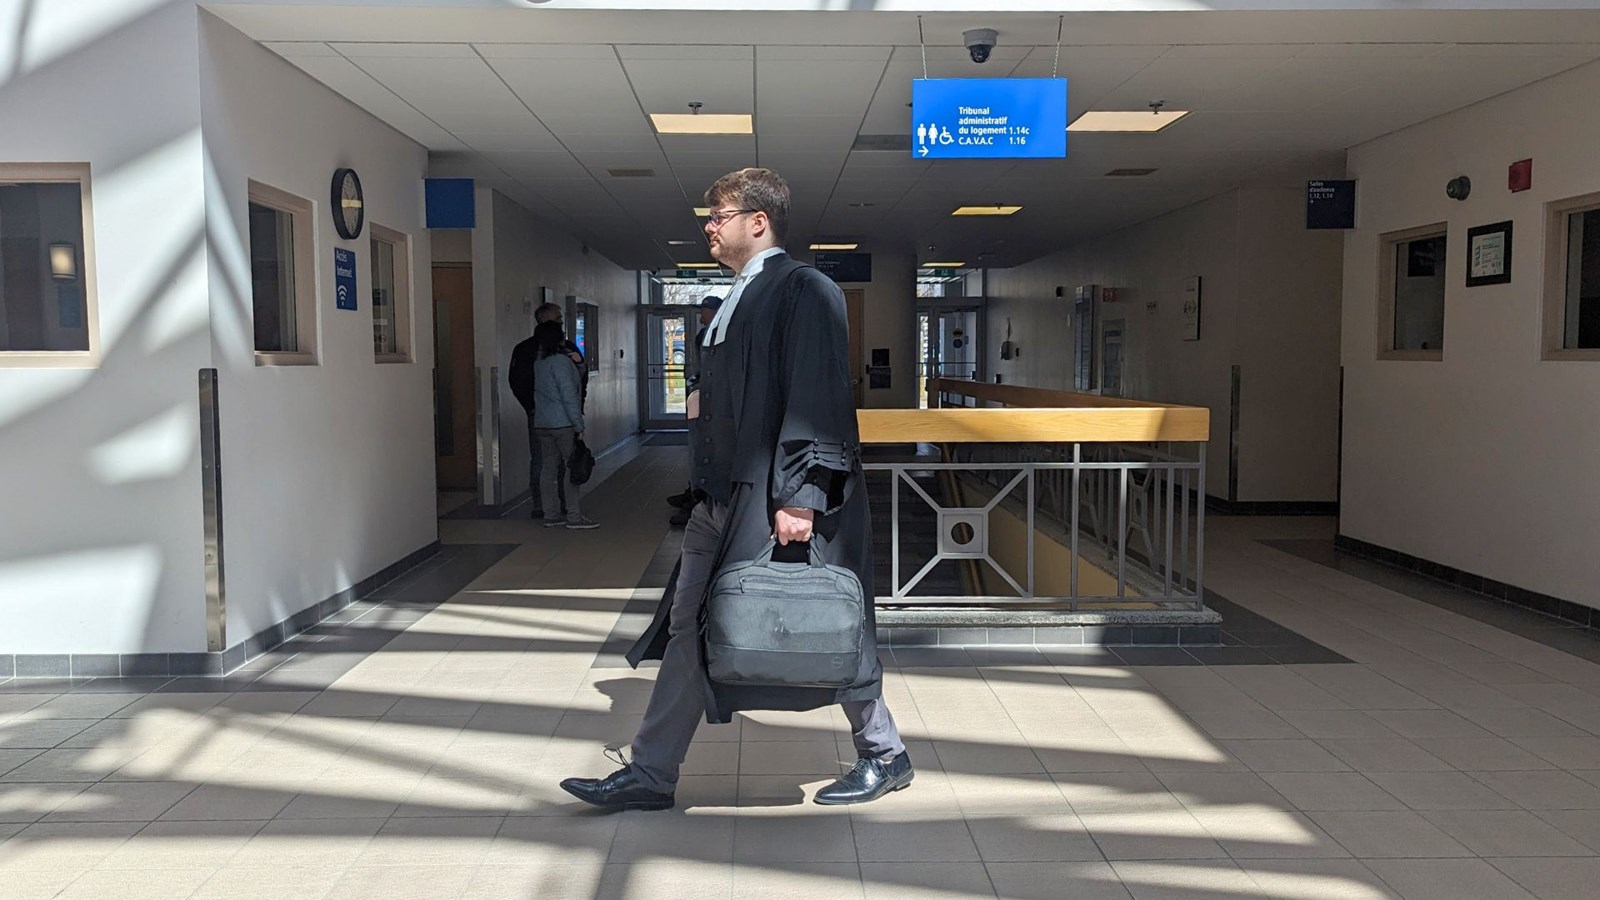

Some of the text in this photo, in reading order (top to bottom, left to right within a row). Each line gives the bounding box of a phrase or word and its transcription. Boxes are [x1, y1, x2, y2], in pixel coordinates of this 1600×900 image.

[958, 107, 990, 115] Tribunal
[958, 117, 1008, 125] administratif
[958, 126, 1029, 137] du logement 1.14c
[958, 137, 1026, 145] C.A.V.A.C 1.16
